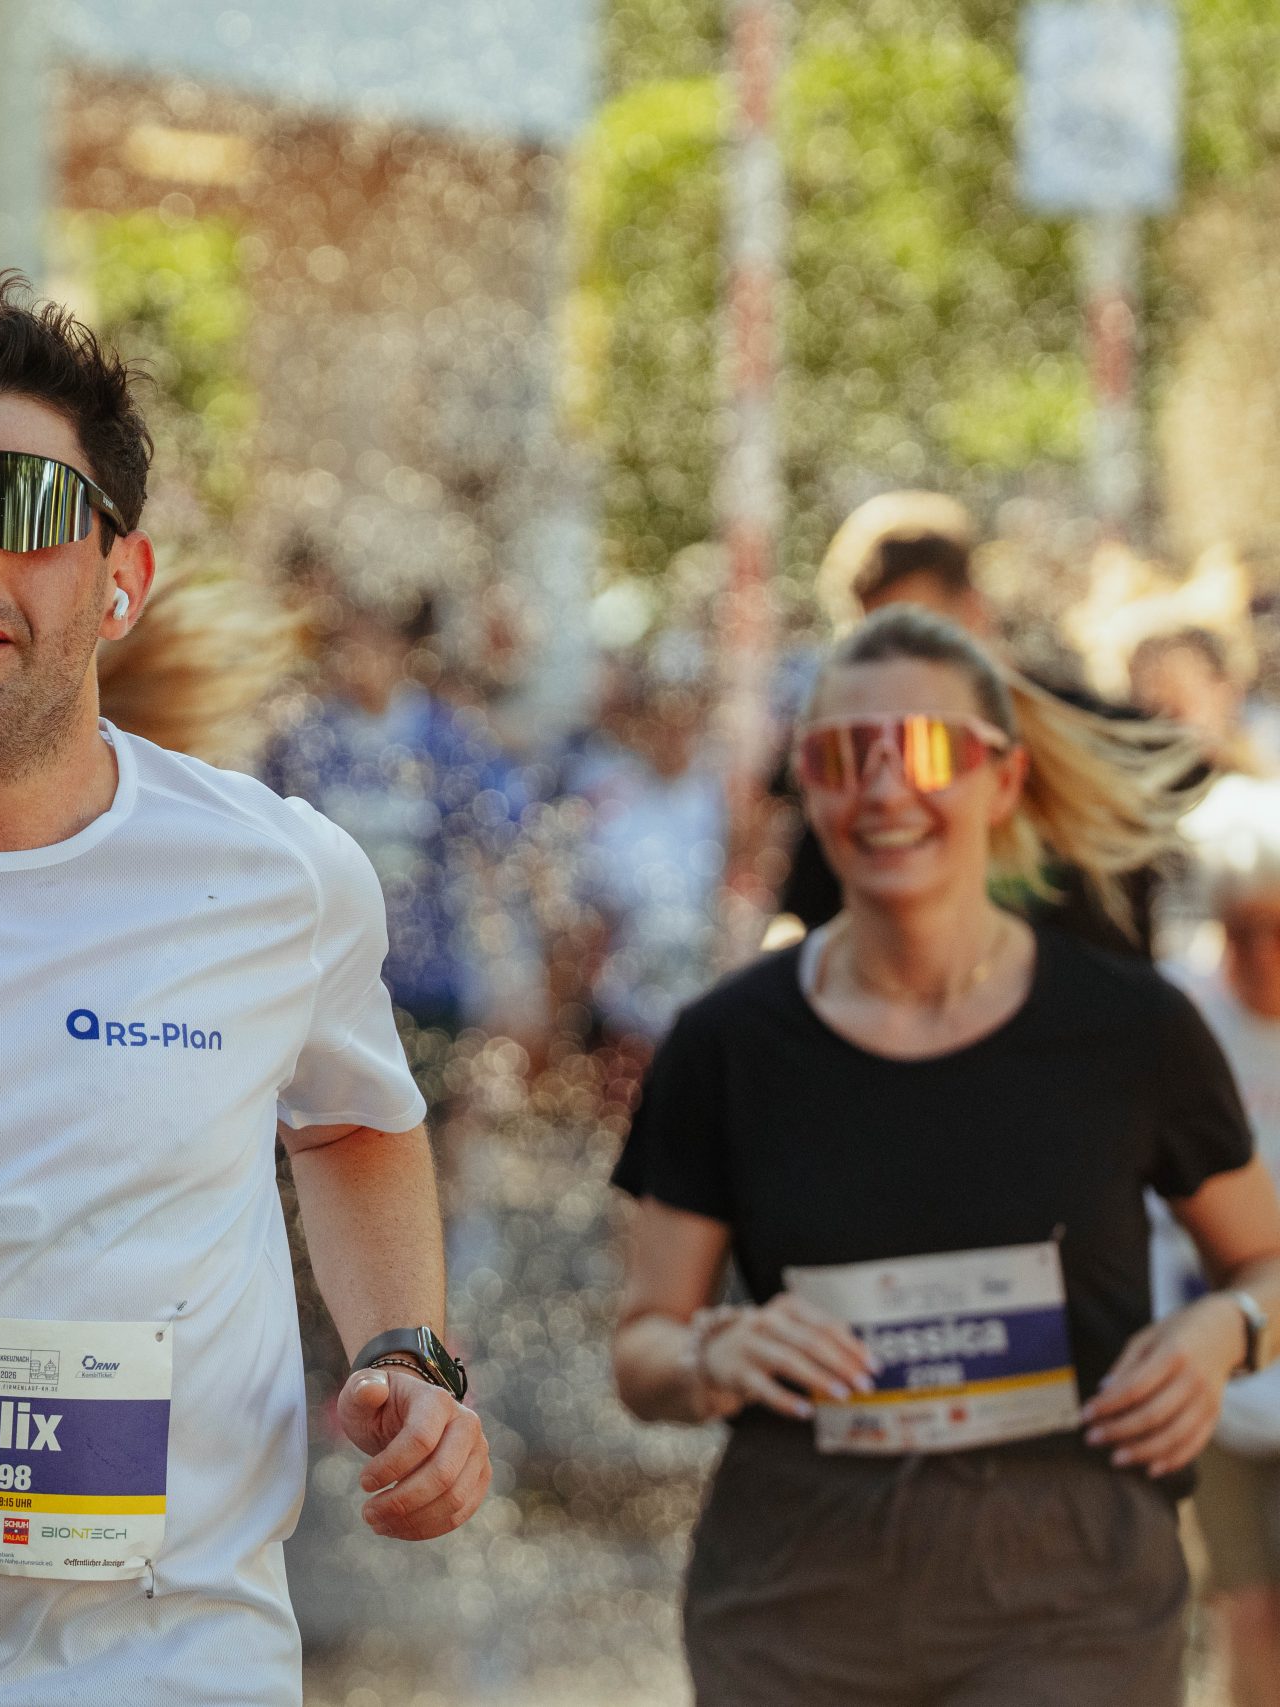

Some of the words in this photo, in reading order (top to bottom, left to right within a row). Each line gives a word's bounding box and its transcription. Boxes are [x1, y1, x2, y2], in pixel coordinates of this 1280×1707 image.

[105, 1022, 222, 1050] RS-Plan
[0, 1355, 30, 1363] KREUZNACH
[0, 1370, 17, 1380] 2026
[15, 1499, 32, 1508] UHR
[4, 1520, 29, 1528] SCHUH
[3, 1534, 28, 1542] PALAST
